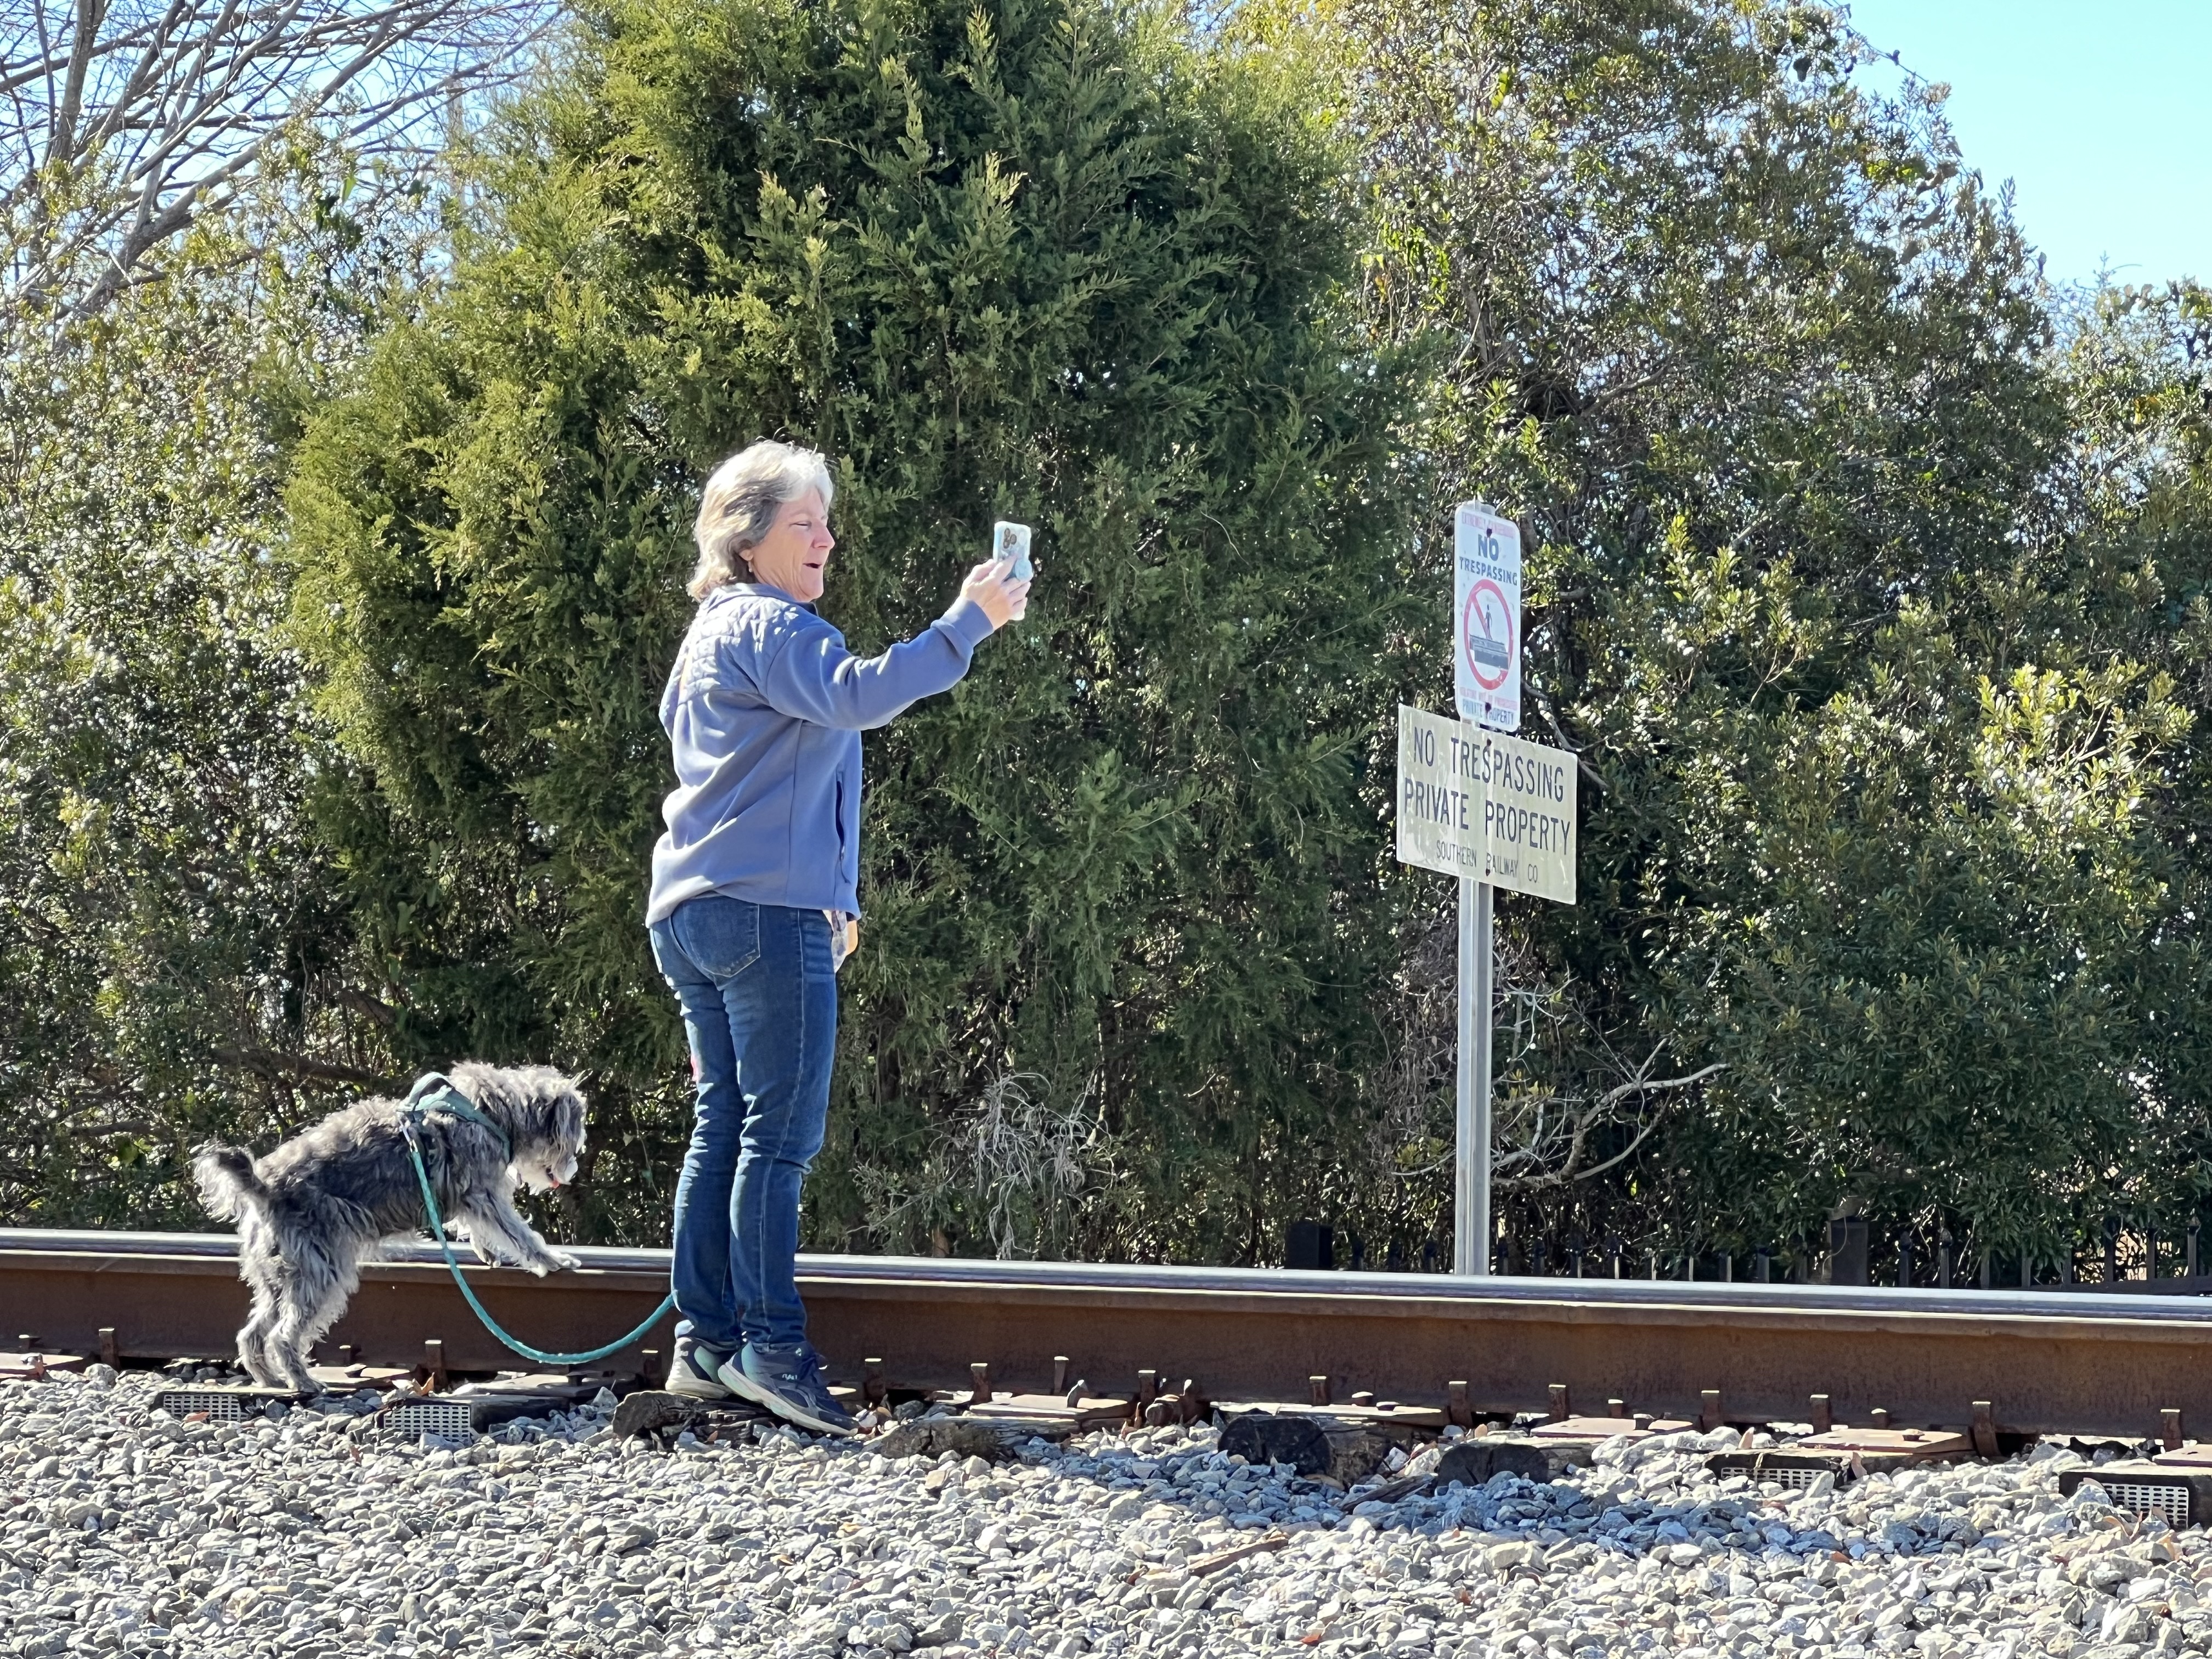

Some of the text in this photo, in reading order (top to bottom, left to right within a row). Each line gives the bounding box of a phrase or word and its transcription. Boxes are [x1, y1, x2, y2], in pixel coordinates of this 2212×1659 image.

[1478, 534, 1499, 561] NO
[1459, 556, 1517, 586] TRESPASSING
[1485, 707, 1514, 725] ROPERTY
[1414, 726, 1564, 802] NO TRESPASSING
[1404, 777, 1571, 855] PRIVATE PROPERTY
[1436, 839, 1477, 867] SOUTHERN
